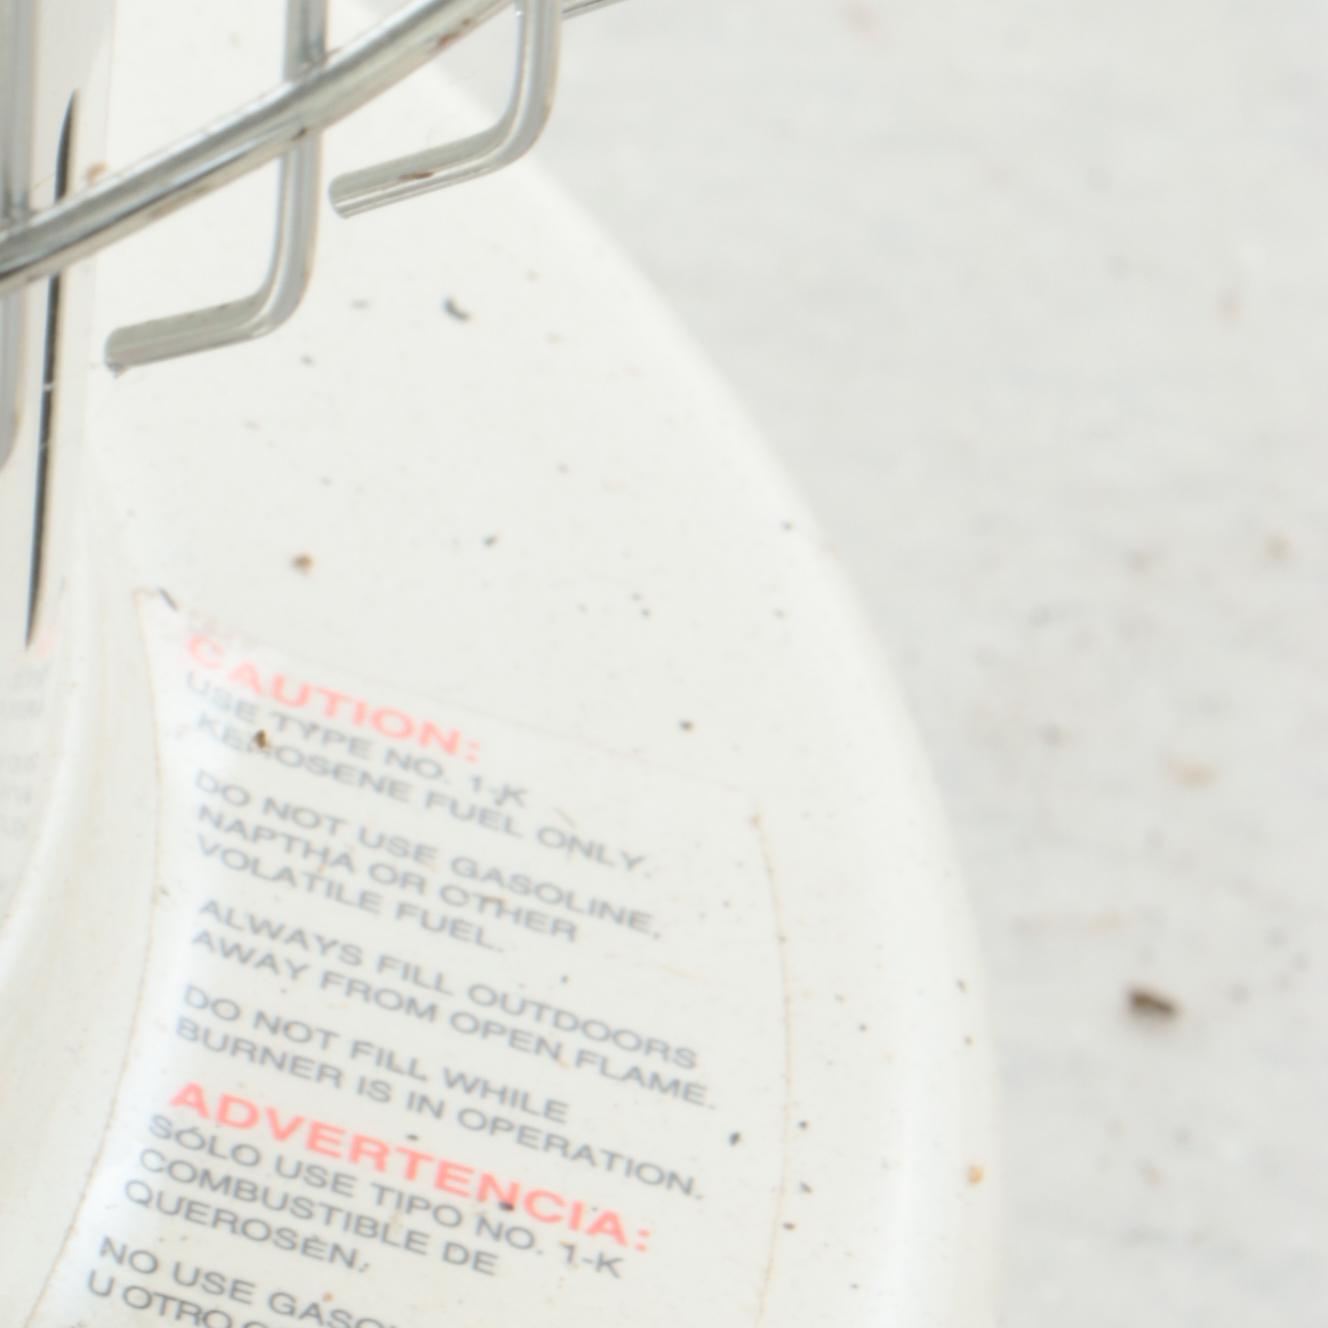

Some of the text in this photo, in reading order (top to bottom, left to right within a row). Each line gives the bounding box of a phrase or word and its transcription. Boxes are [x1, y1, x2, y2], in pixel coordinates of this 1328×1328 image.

[185, 669, 529, 809] USE TYPE NO. 1-K
[186, 632, 480, 762] CAUTION:
[195, 769, 250, 808] DO
[263, 797, 340, 838] NOT
[358, 826, 437, 867] USE
[197, 711, 413, 804] KEROSENE
[425, 790, 523, 839] FUEL
[197, 804, 579, 944] NAPTHA OR OTHER
[197, 834, 505, 954] VOLATILE FUEL.
[191, 928, 718, 1111] AWAY FROM OPEN FLAME.
[198, 898, 699, 1071] ALWAYS FILL OUTDOORS
[176, 1016, 705, 1201] BURNER IS IN OPERATION.
[182, 984, 570, 1124] DO NOT FILL WHILE
[139, 1148, 500, 1277] COMBUSTIBLE DE
[170, 1082, 651, 1252] ADVERTENCIA:
[274, 1154, 358, 1198] USE
[372, 1182, 463, 1230] TIPO
[475, 1213, 543, 1257] NO.
[560, 1240, 626, 1280] 1-K
[86, 1272, 116, 1300] U
[99, 1236, 159, 1276] NO
[172, 1260, 255, 1304] USE
